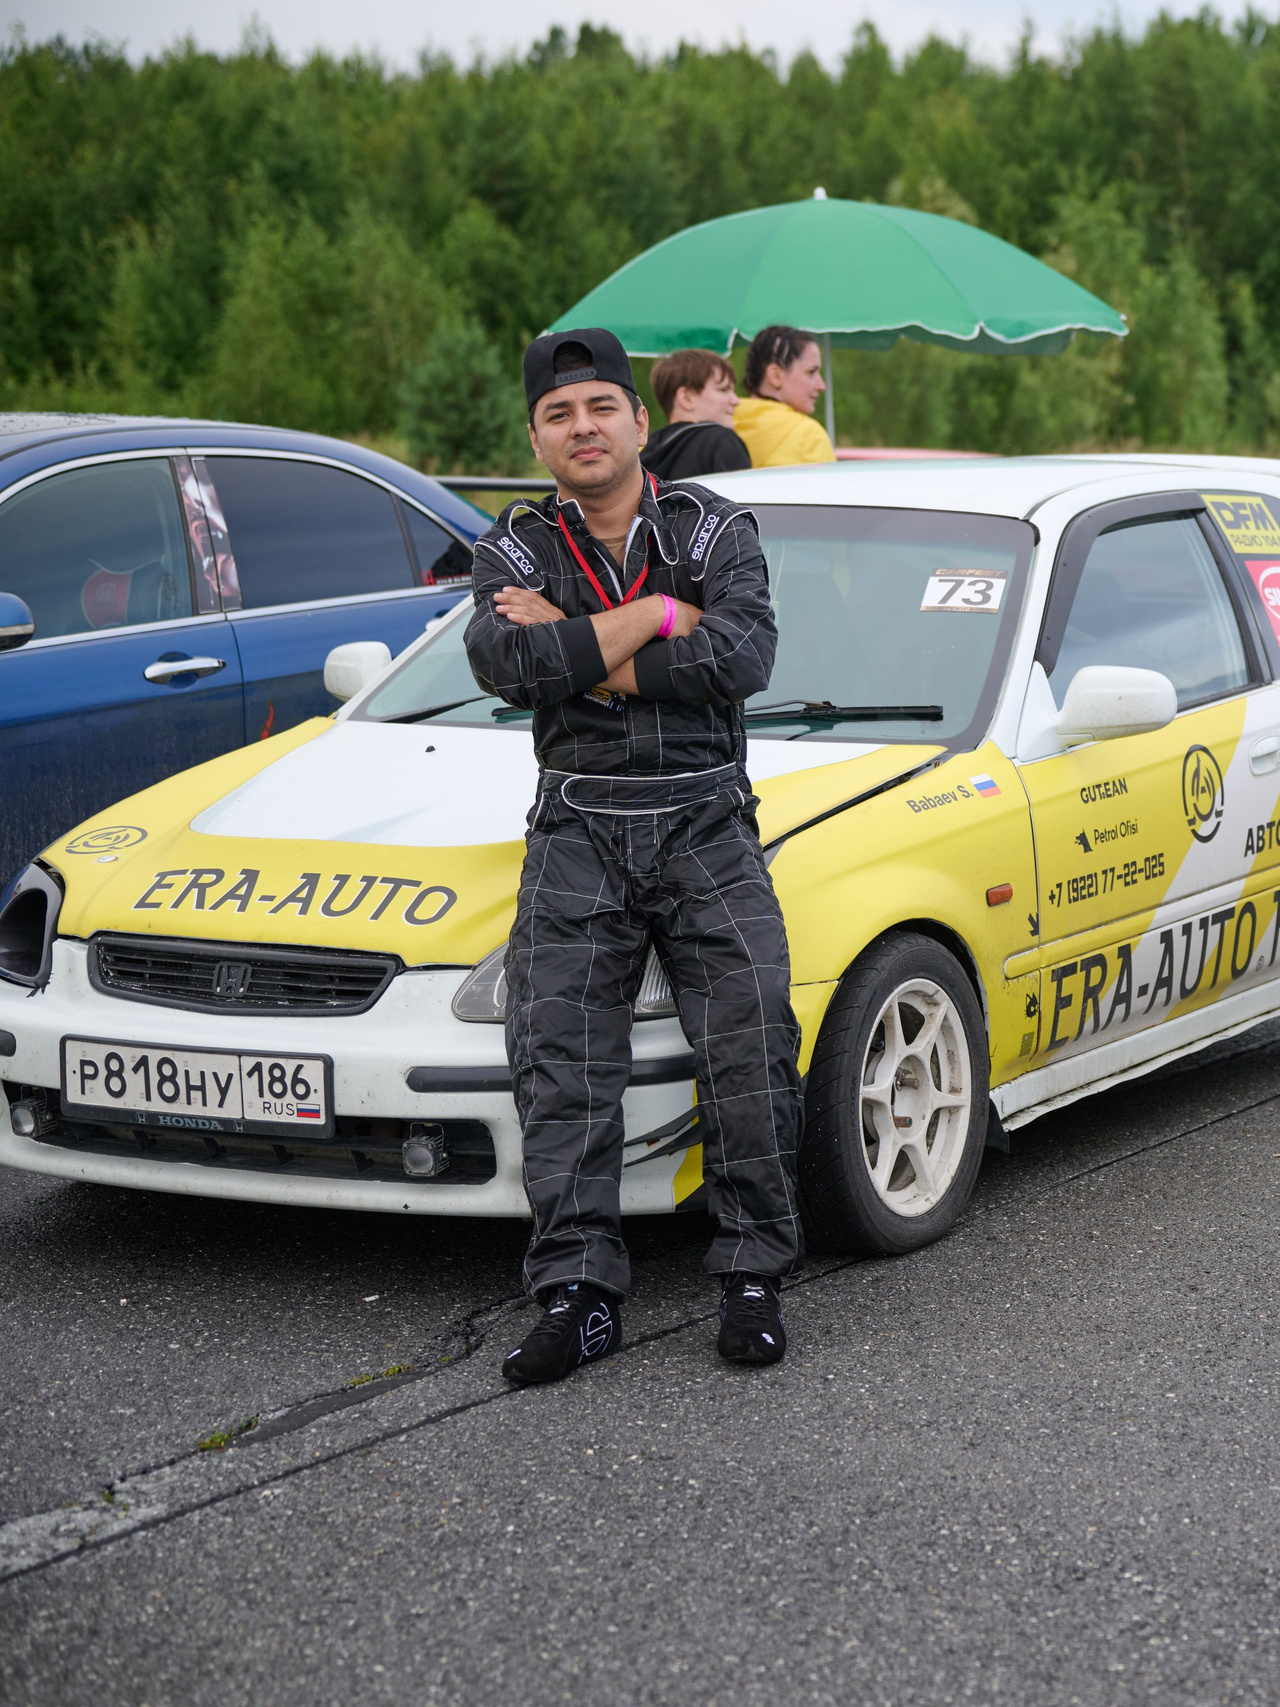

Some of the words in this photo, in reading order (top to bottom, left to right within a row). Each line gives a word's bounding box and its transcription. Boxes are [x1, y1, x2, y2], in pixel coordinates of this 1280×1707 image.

[1210, 501, 1277, 531] DFM
[937, 579, 994, 606] 73
[906, 791, 958, 814] Babaev
[956, 785, 974, 799] S.
[1093, 824, 1118, 845] Petrol
[1119, 818, 1139, 838] Ofisi
[1049, 882, 1063, 908] +7
[1102, 852, 1165, 894] 77-22-025
[132, 868, 459, 927] ERA-AUTO
[246, 1061, 311, 1101] 186
[158, 1115, 224, 1131] HONDA
[262, 1101, 295, 1117] RUS
